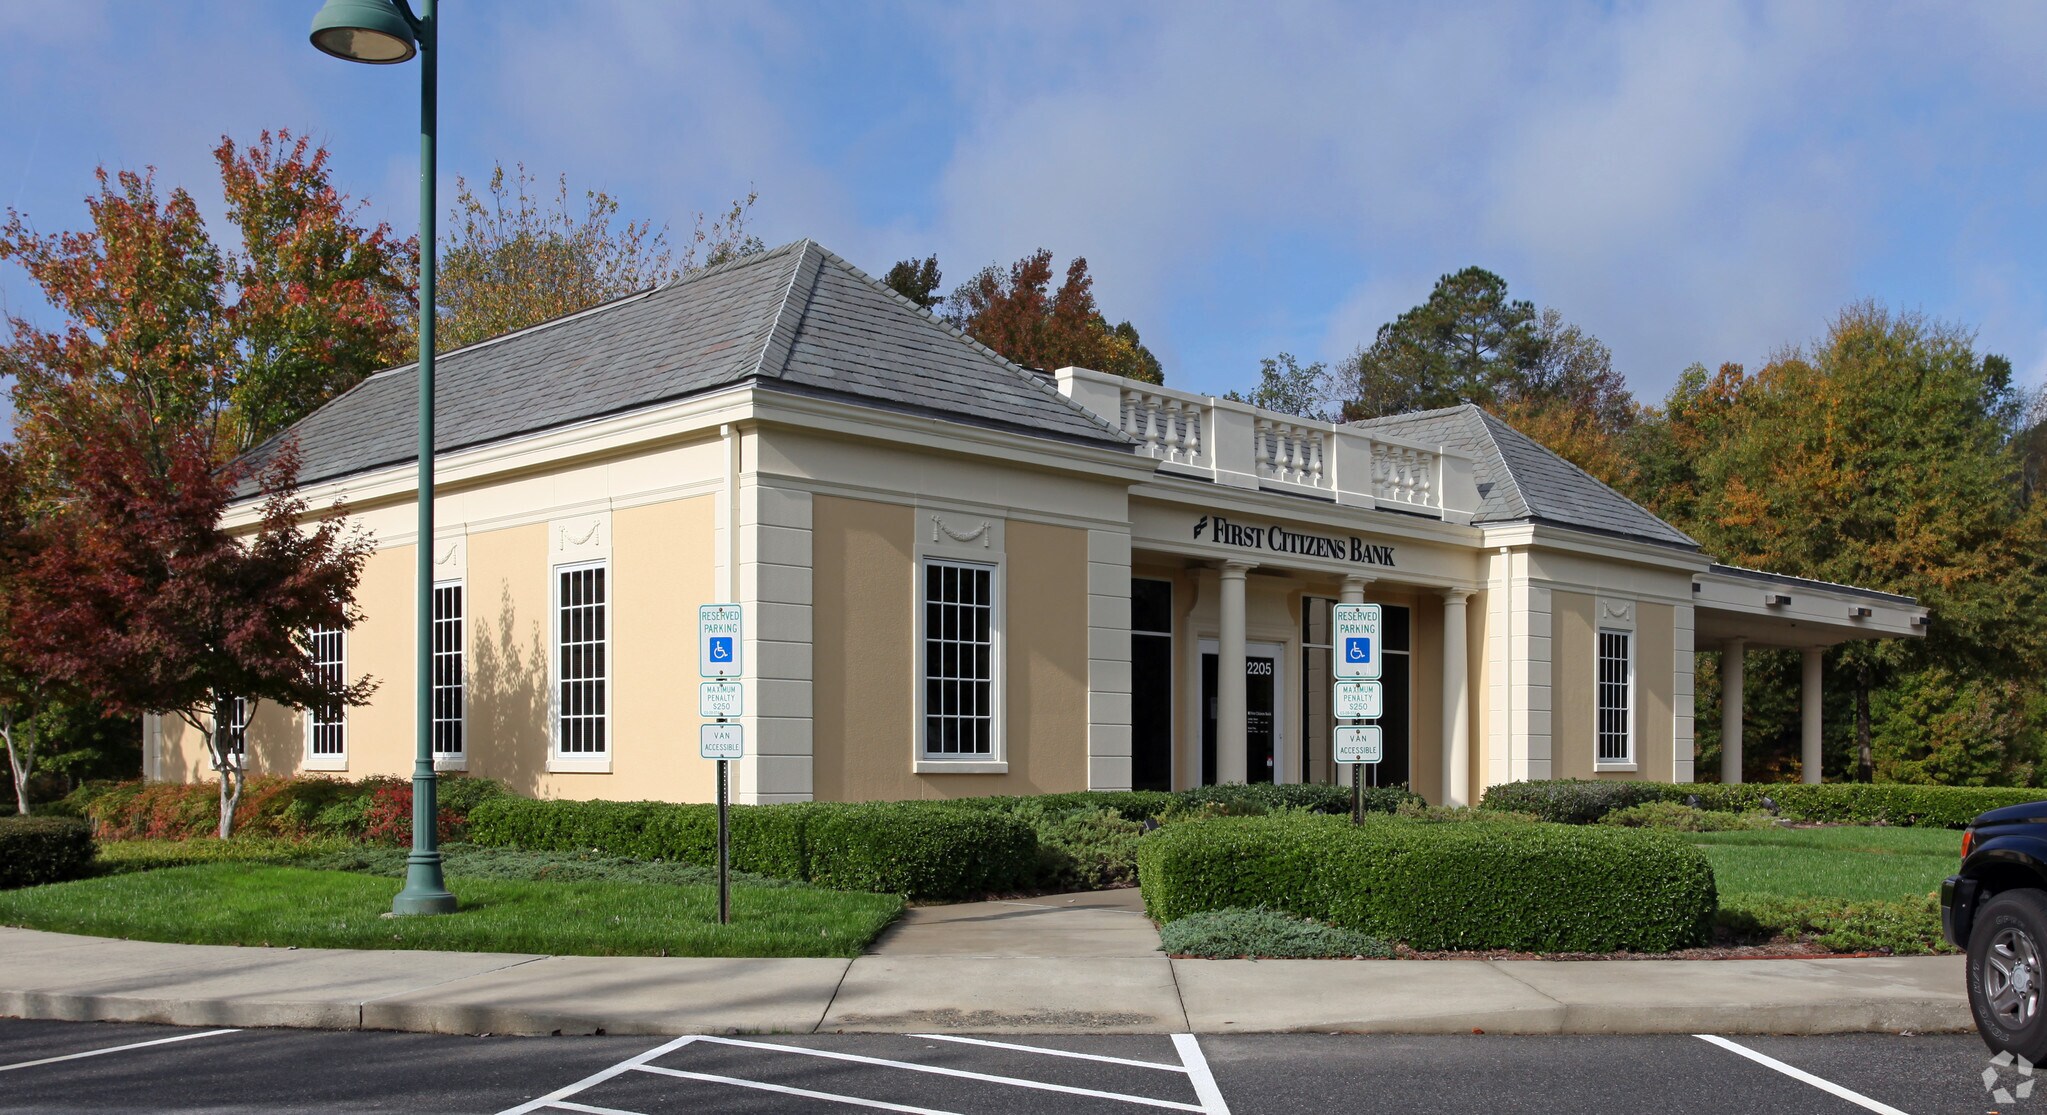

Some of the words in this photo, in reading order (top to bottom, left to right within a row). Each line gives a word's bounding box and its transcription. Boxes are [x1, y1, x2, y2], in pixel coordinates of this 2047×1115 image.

[1212, 516, 1264, 548] FIRST
[1268, 525, 1346, 560] CITIZENS
[1349, 536, 1396, 567] BANK
[702, 611, 740, 621] RESERVED
[1338, 611, 1378, 621] RESERVED
[704, 624, 738, 633] PARKING
[1340, 624, 1376, 634] PARKING
[1247, 661, 1272, 675] 2205
[707, 694, 735, 702] PENALTY
[1343, 694, 1373, 702] PENALTY
[704, 743, 740, 751] ACCESSIBLE
[1340, 746, 1377, 754] ACCESSIBLE
